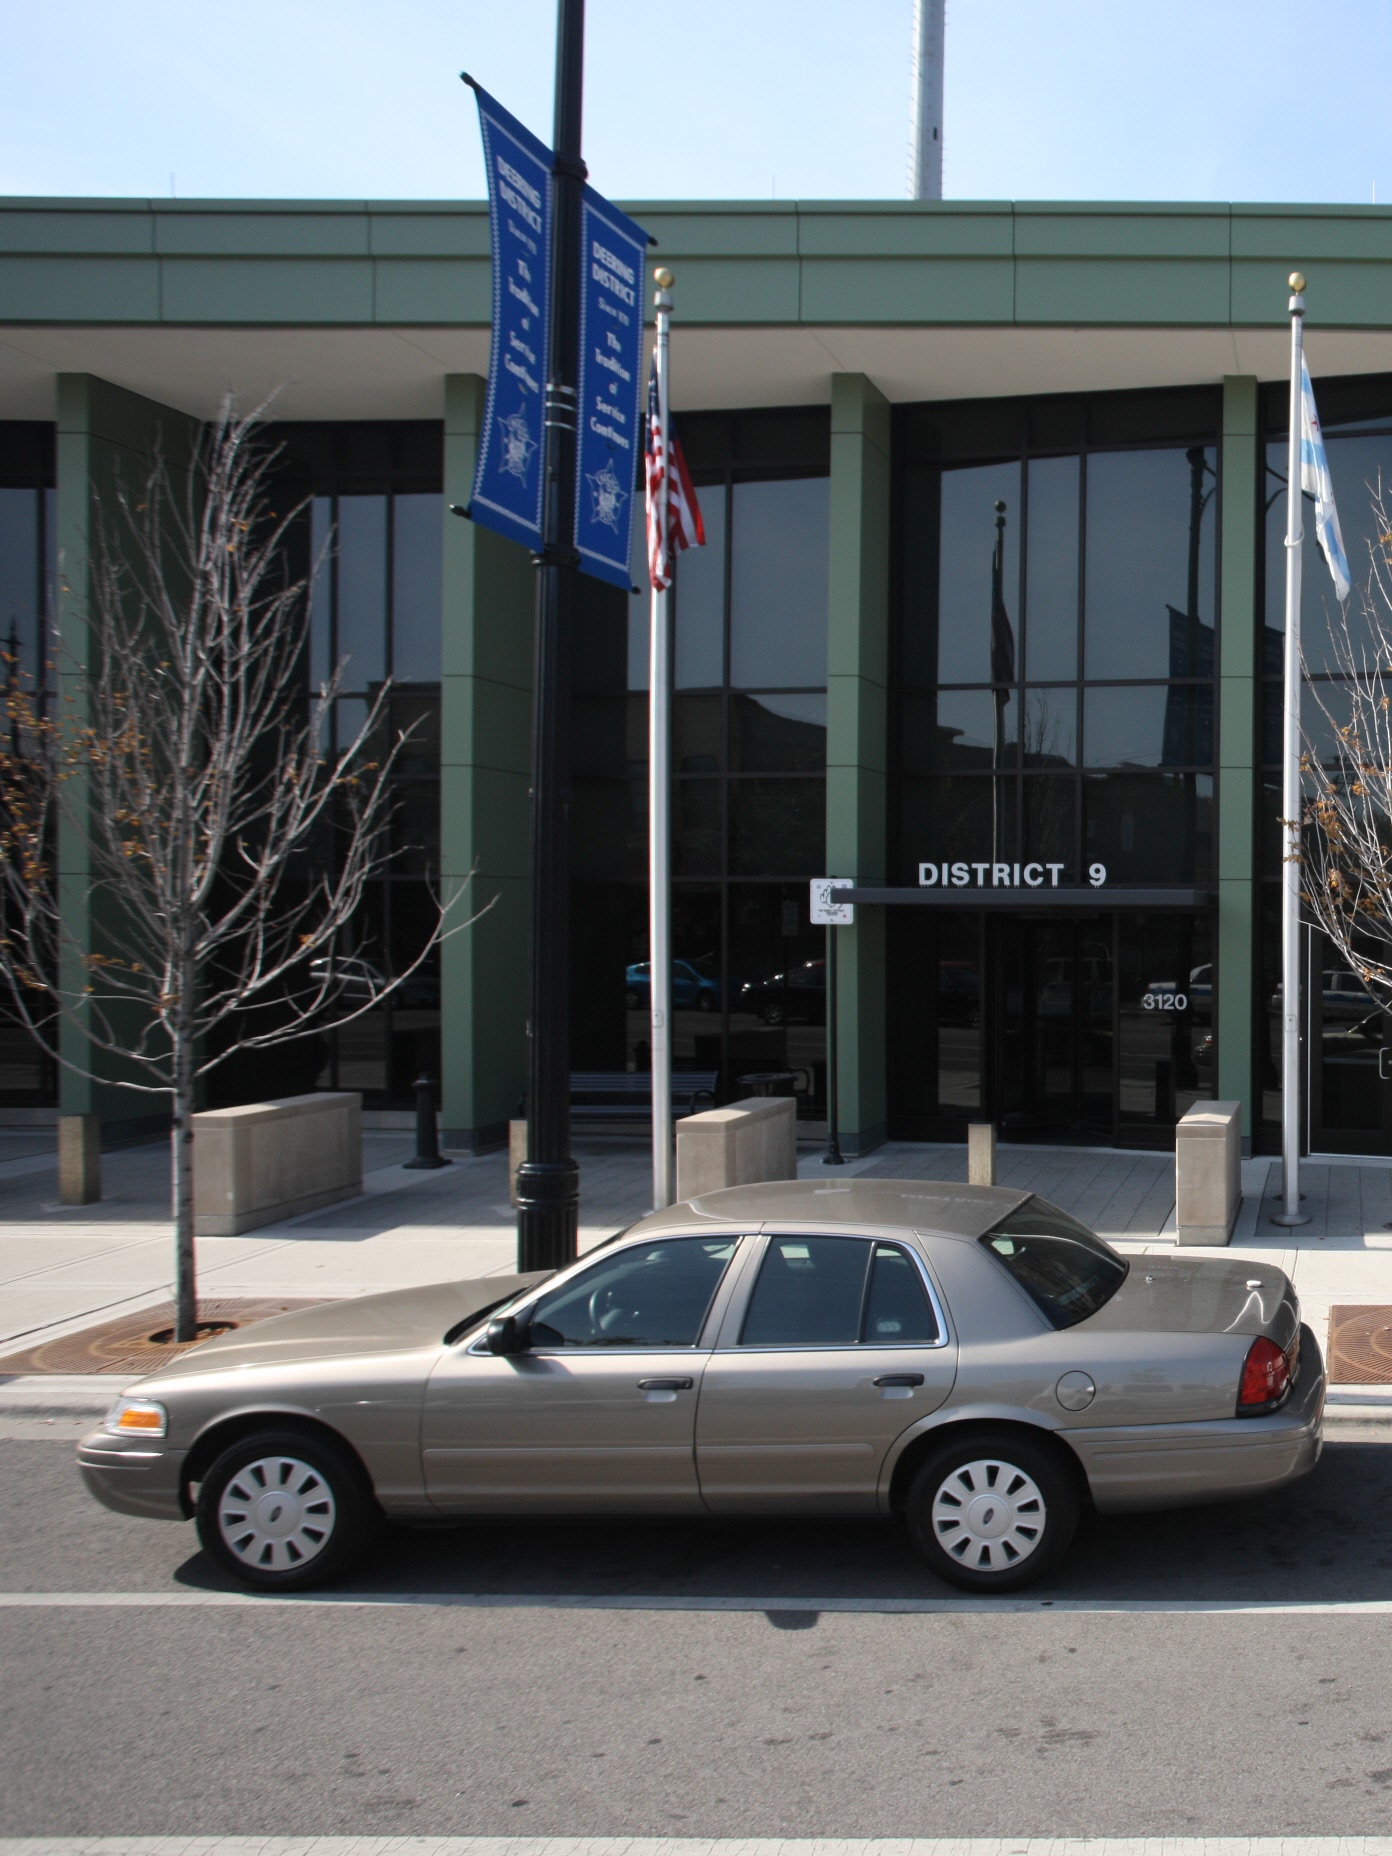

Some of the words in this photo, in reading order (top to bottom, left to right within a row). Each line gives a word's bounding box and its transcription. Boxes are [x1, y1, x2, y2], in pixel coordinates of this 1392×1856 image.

[499, 179, 542, 235] DISTRICT
[592, 240, 635, 286] DEERING
[592, 262, 636, 307] DISTRICT
[918, 863, 1065, 886] DISTRICT
[1089, 863, 1107, 887] 9
[1143, 994, 1187, 1010] 3120
